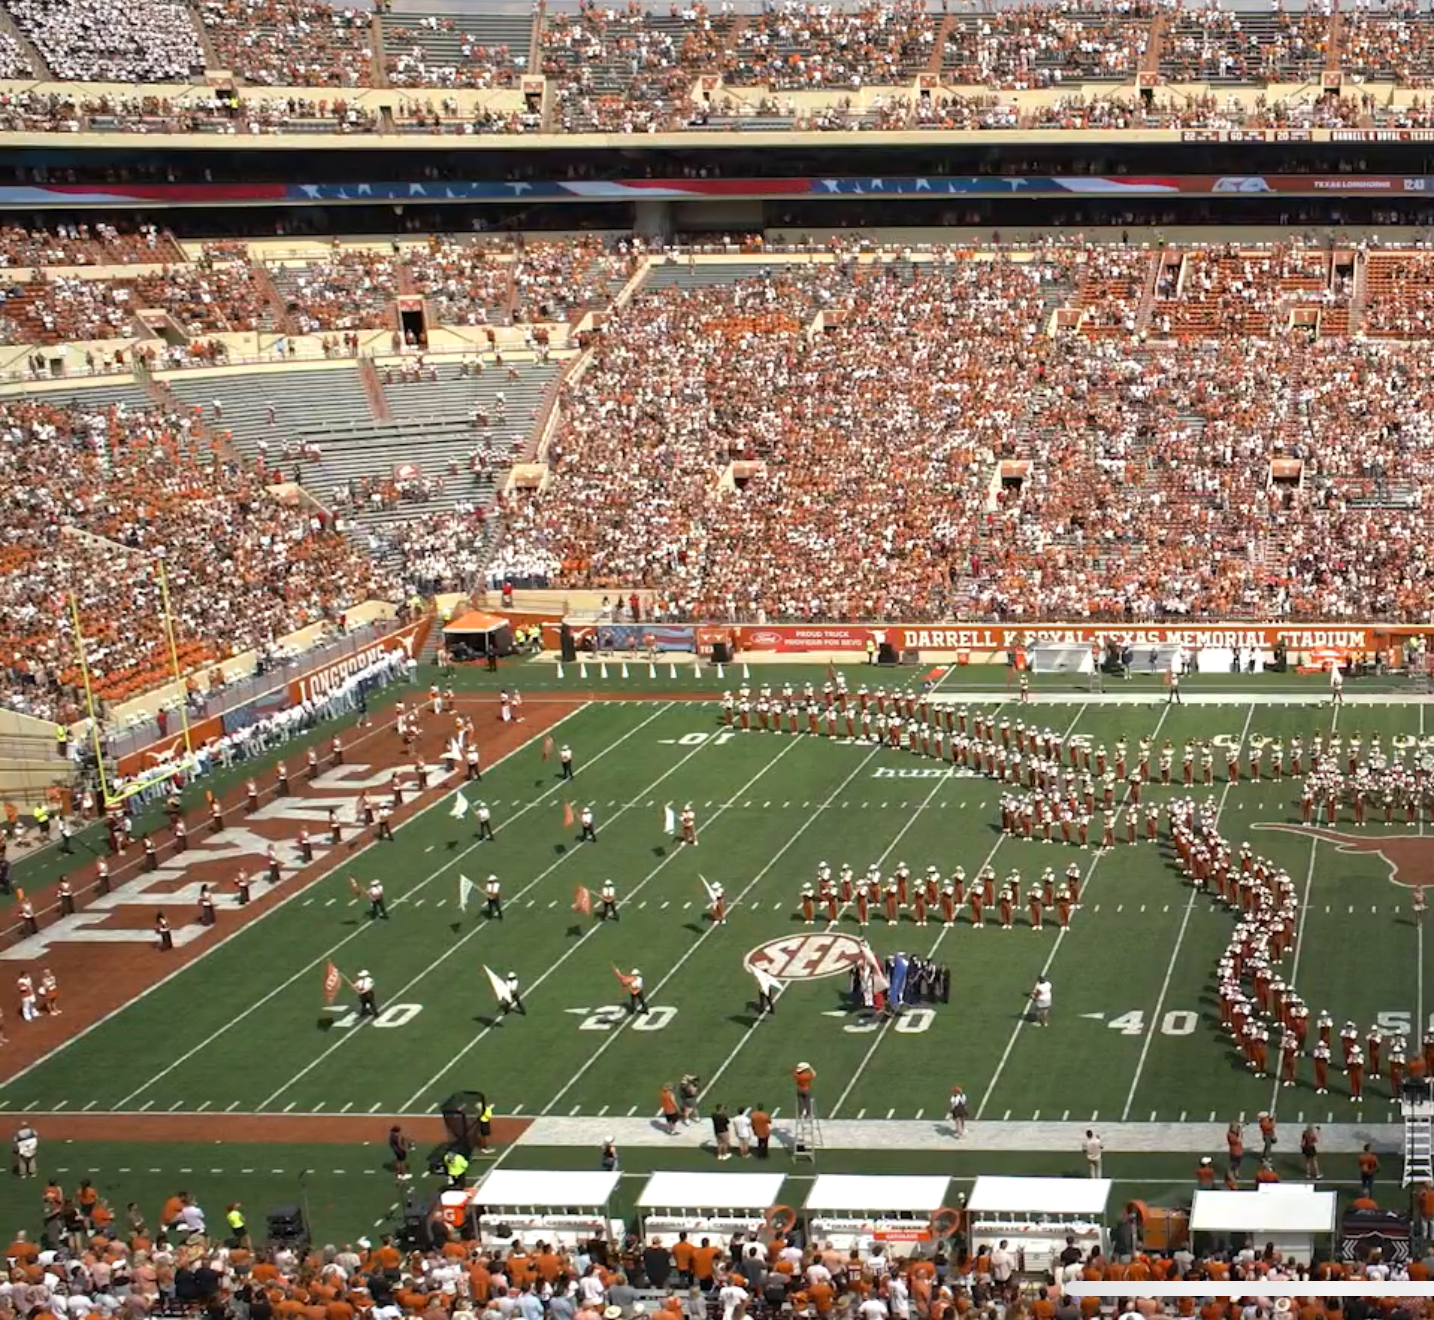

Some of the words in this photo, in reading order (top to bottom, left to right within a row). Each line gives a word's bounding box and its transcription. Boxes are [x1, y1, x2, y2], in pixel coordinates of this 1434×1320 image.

[1184, 132, 1196, 141] 22
[1277, 132, 1290, 141] 20
[1332, 131, 1367, 142] DARRELL
[1376, 131, 1401, 142] ROYAL
[1410, 131, 1434, 142] TEXAS
[1314, 180, 1341, 188] TEXAS
[1342, 180, 1391, 188] LONGHORNS
[756, 634, 776, 642] Ford
[796, 630, 823, 638] PROUD
[825, 630, 849, 638] TRUCK
[904, 631, 997, 647] DARRELL
[1163, 631, 1271, 648] MEMORIAL
[1277, 631, 1366, 648] STADIUM
[298, 644, 386, 702] LONGHORNS
[0, 763, 459, 960] TEXAS
[755, 935, 862, 977] SEC
[332, 1004, 424, 1028] 10
[579, 1005, 679, 1030] 20
[1108, 1010, 1199, 1035] 40
[443, 1208, 455, 1221] G
